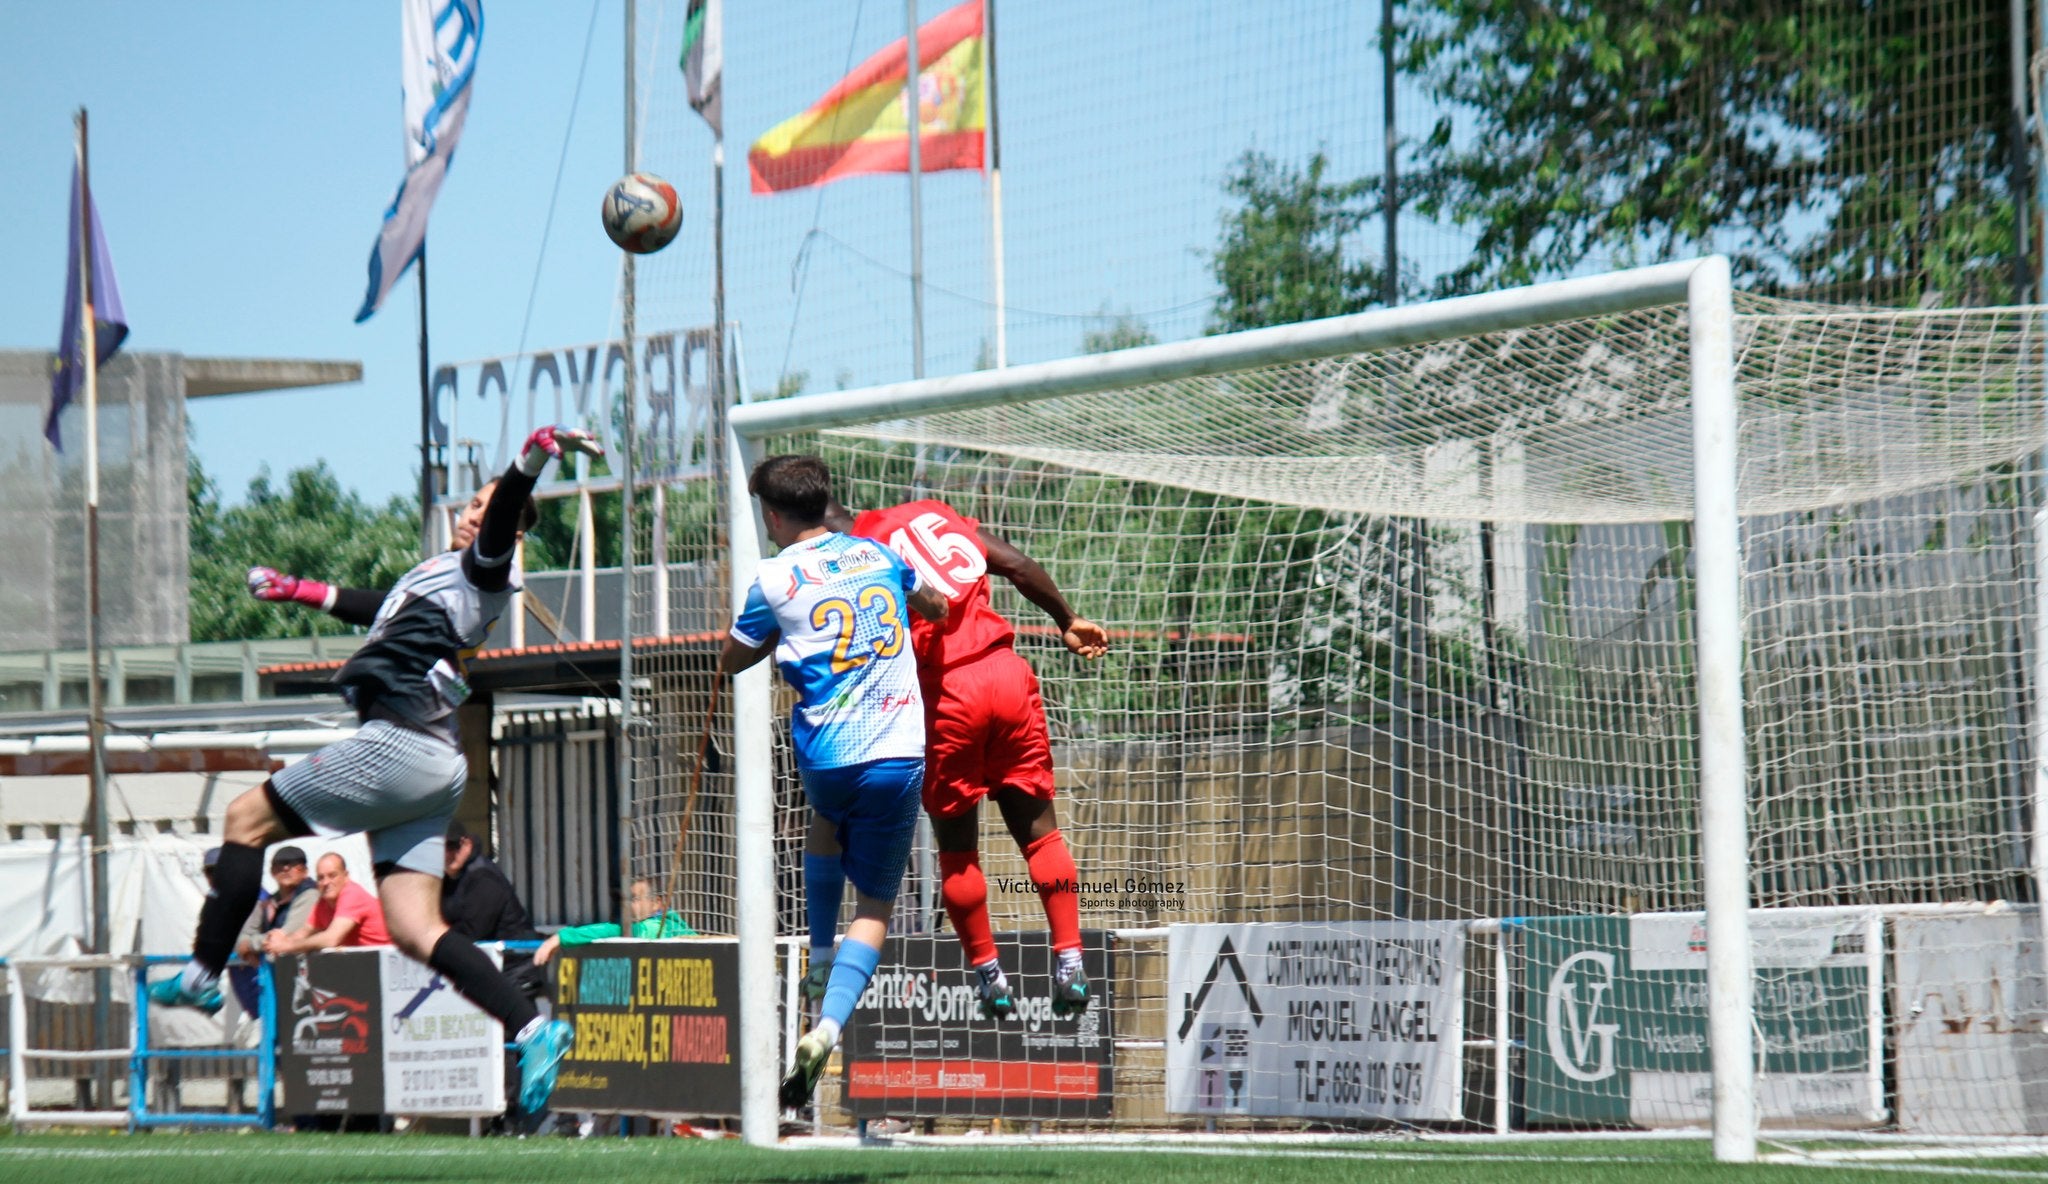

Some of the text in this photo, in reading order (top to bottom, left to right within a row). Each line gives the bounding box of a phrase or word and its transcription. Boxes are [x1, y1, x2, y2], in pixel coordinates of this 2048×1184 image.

[889, 511, 988, 599] 15
[808, 582, 905, 675] 23
[558, 957, 577, 1005] EN
[637, 957, 654, 1006] EL
[656, 958, 718, 1008] PARTIDO.
[574, 1012, 648, 1070] DESCANSO,
[651, 1014, 670, 1063] EN
[671, 1014, 731, 1065] MADRID.
[1287, 1000, 1362, 1042] MIGUEL
